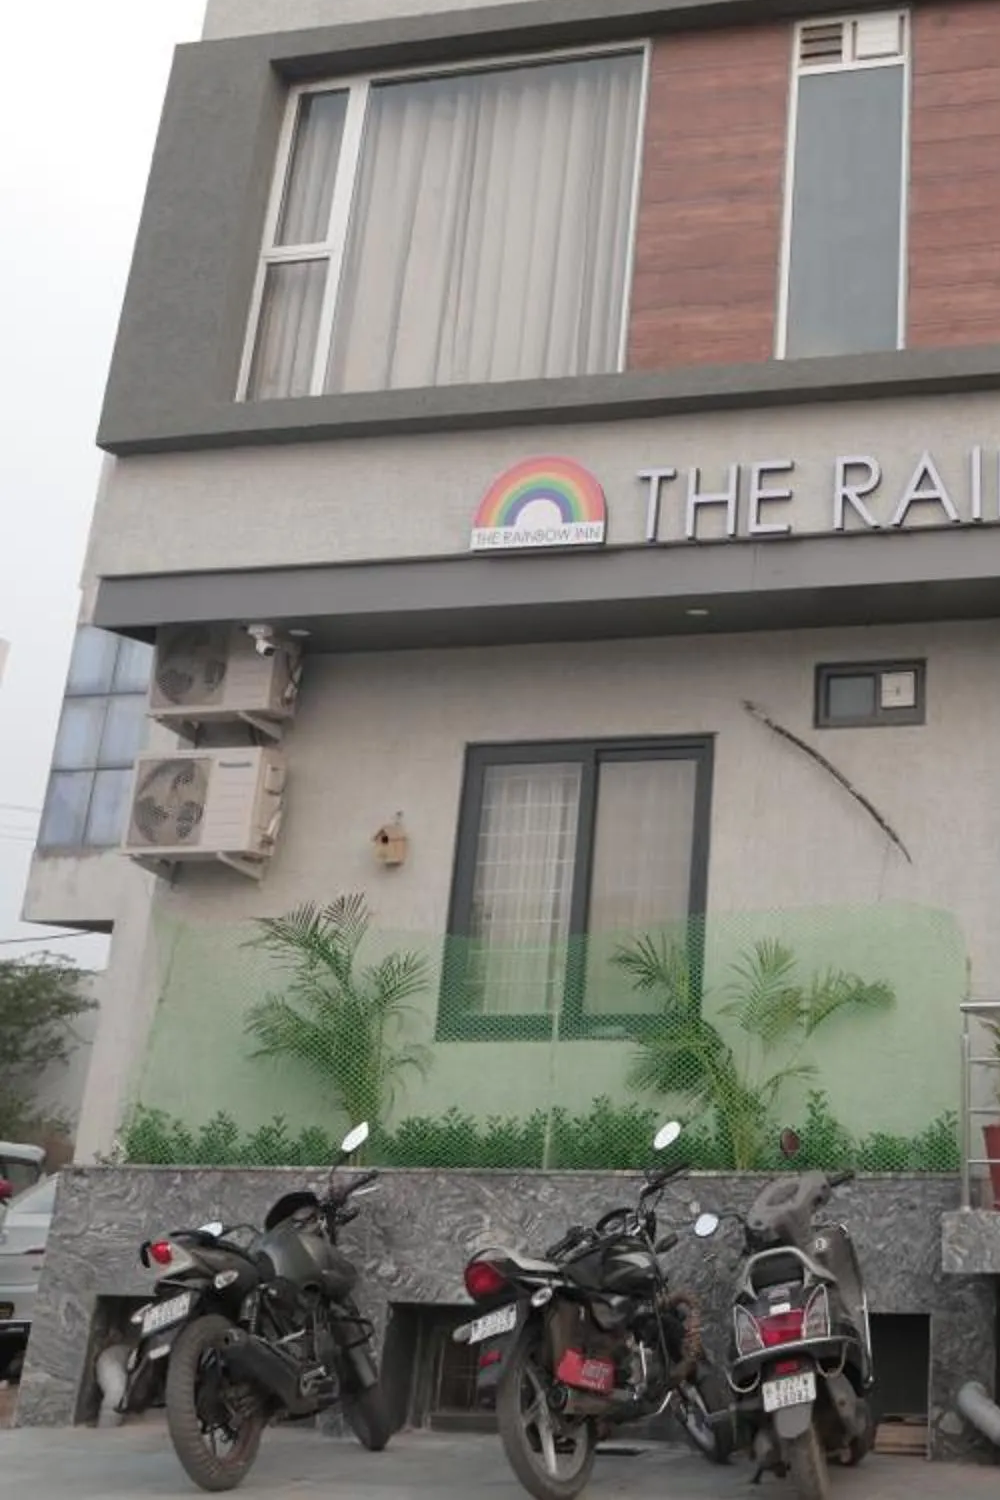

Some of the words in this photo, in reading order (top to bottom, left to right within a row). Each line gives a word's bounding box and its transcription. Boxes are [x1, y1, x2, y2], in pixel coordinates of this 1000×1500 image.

[637, 460, 795, 543] THE
[476, 531, 501, 545] THE
[503, 527, 570, 545] RAINBOW
[573, 526, 601, 541] INN
